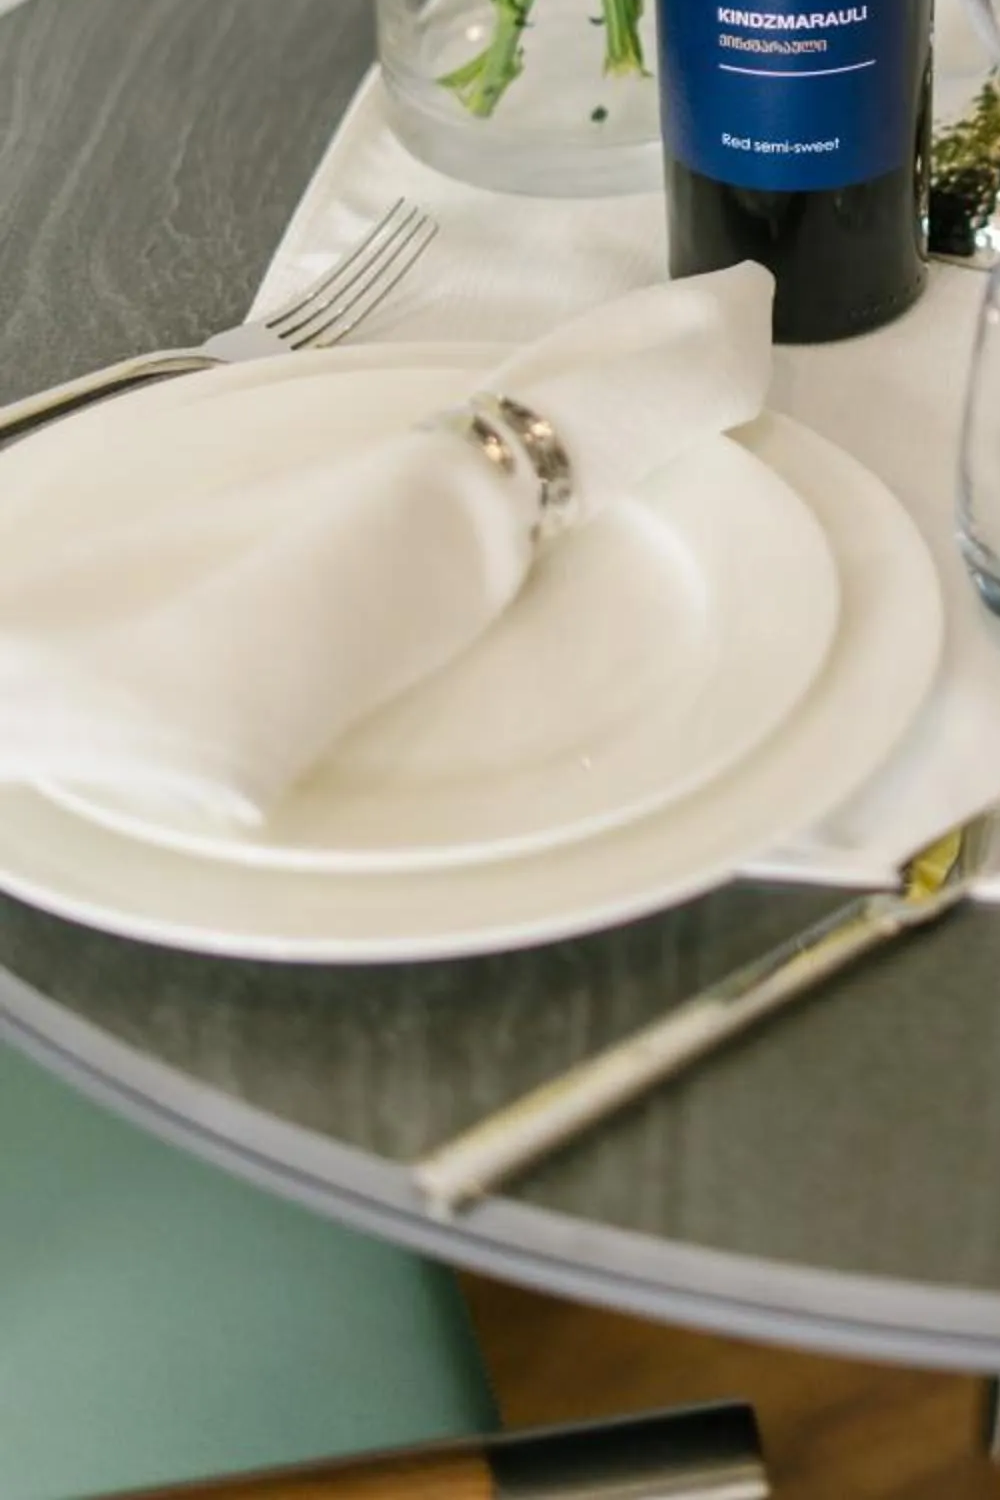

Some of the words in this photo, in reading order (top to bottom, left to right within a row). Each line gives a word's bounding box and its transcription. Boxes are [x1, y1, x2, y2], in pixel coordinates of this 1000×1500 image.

[717, 5, 867, 30] KINDZMARAULI
[721, 132, 751, 151] Red
[753, 136, 840, 155] semi-sweet
